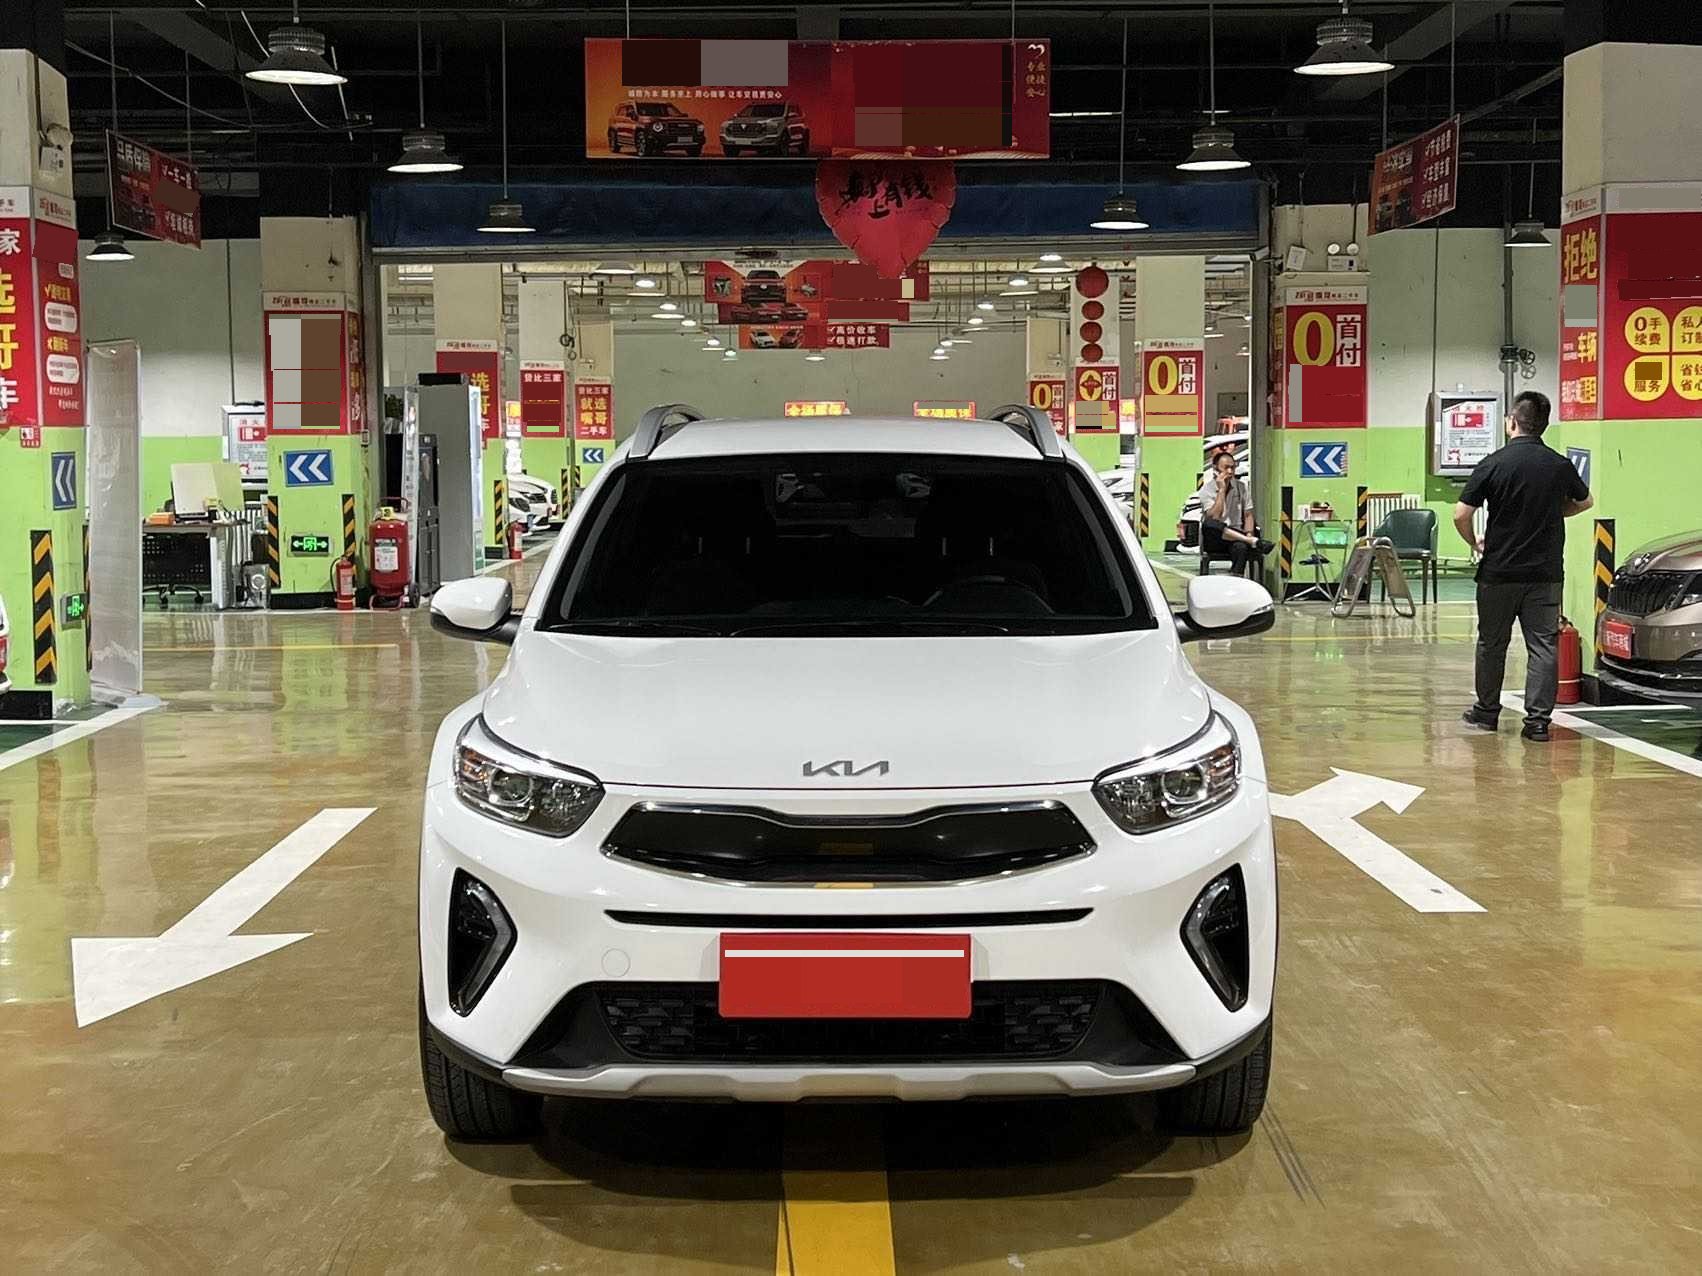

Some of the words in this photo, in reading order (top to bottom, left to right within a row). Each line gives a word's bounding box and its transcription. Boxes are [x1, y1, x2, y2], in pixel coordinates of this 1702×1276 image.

[1563, 228, 1598, 283] 拒绝
[836, 325, 876, 335] 高价收车
[1634, 316, 1662, 331] 0手
[1293, 311, 1335, 367] 0
[1336, 314, 1361, 367] 首付
[1634, 332, 1662, 346] 续费
[1149, 355, 1178, 395] 0
[1178, 357, 1196, 394] 首付
[1634, 380, 1661, 393] 服务
[1033, 383, 1052, 410] 0
[803, 760, 889, 777] KIA
